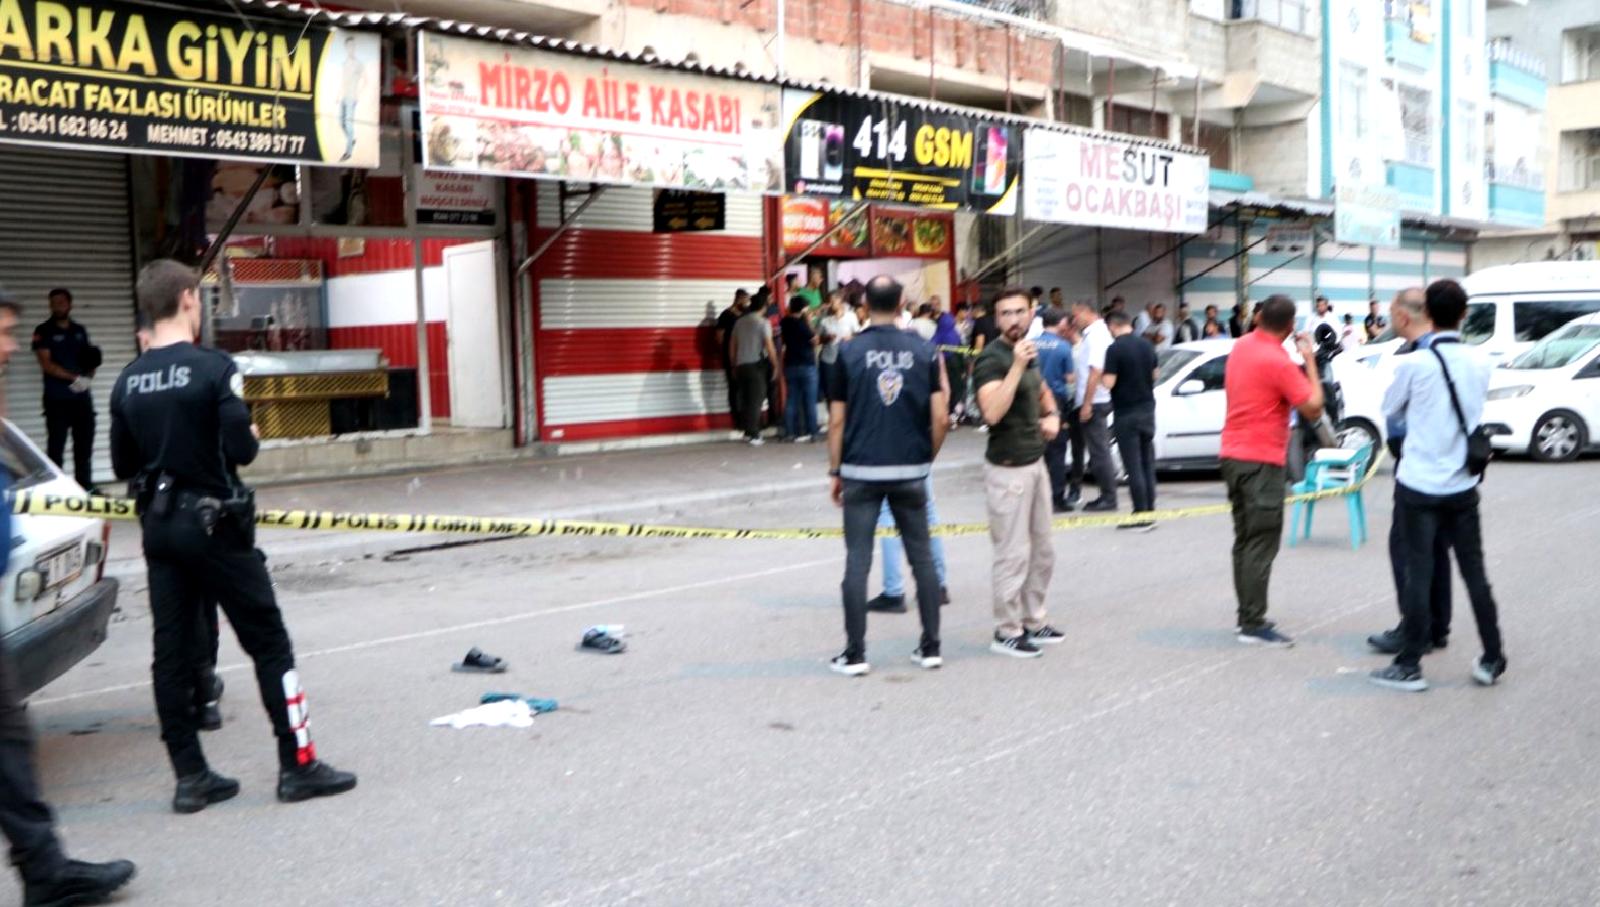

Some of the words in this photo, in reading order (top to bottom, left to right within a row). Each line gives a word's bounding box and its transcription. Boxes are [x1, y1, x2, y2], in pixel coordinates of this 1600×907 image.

[84, 85, 180, 118] FAZLASI
[185, 89, 287, 129] ÜRÜNLER
[478, 51, 571, 115] MİRZO
[582, 67, 640, 126] AİLE
[649, 85, 741, 135] KASABI
[147, 124, 208, 146] MEHMET
[853, 115, 908, 162] 414
[915, 123, 974, 169] GSM
[1066, 182, 1181, 228] OCAKBAŞI
